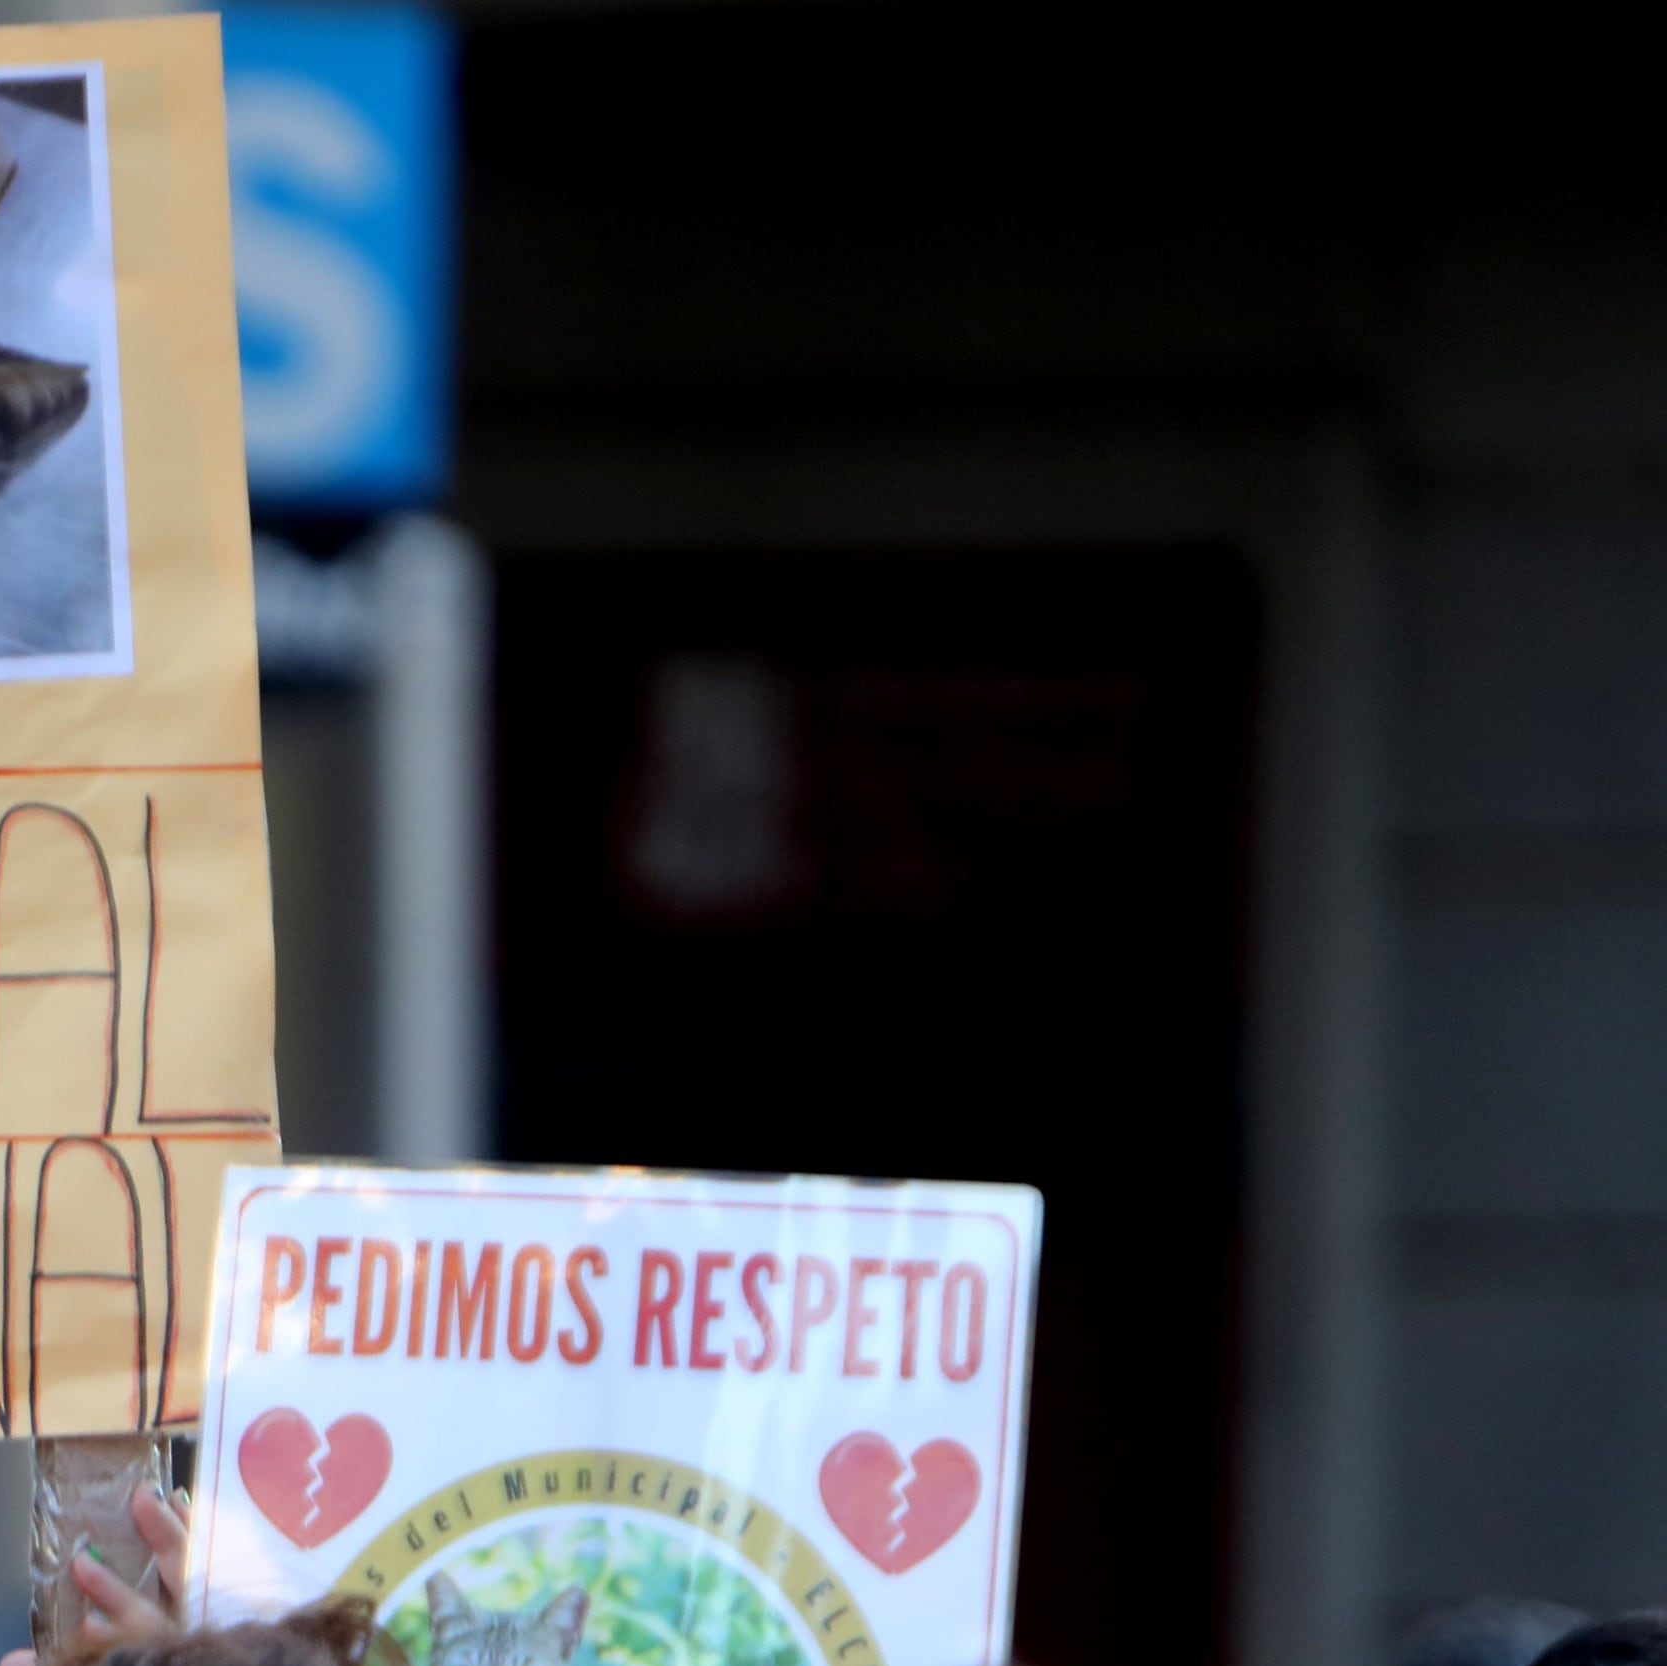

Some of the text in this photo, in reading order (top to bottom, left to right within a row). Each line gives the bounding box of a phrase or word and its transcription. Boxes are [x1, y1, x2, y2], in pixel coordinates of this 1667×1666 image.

[254, 1235, 990, 1384] PEDIMOS RESPETO
[403, 1488, 475, 1554] del
[502, 1459, 758, 1538] Municipal
